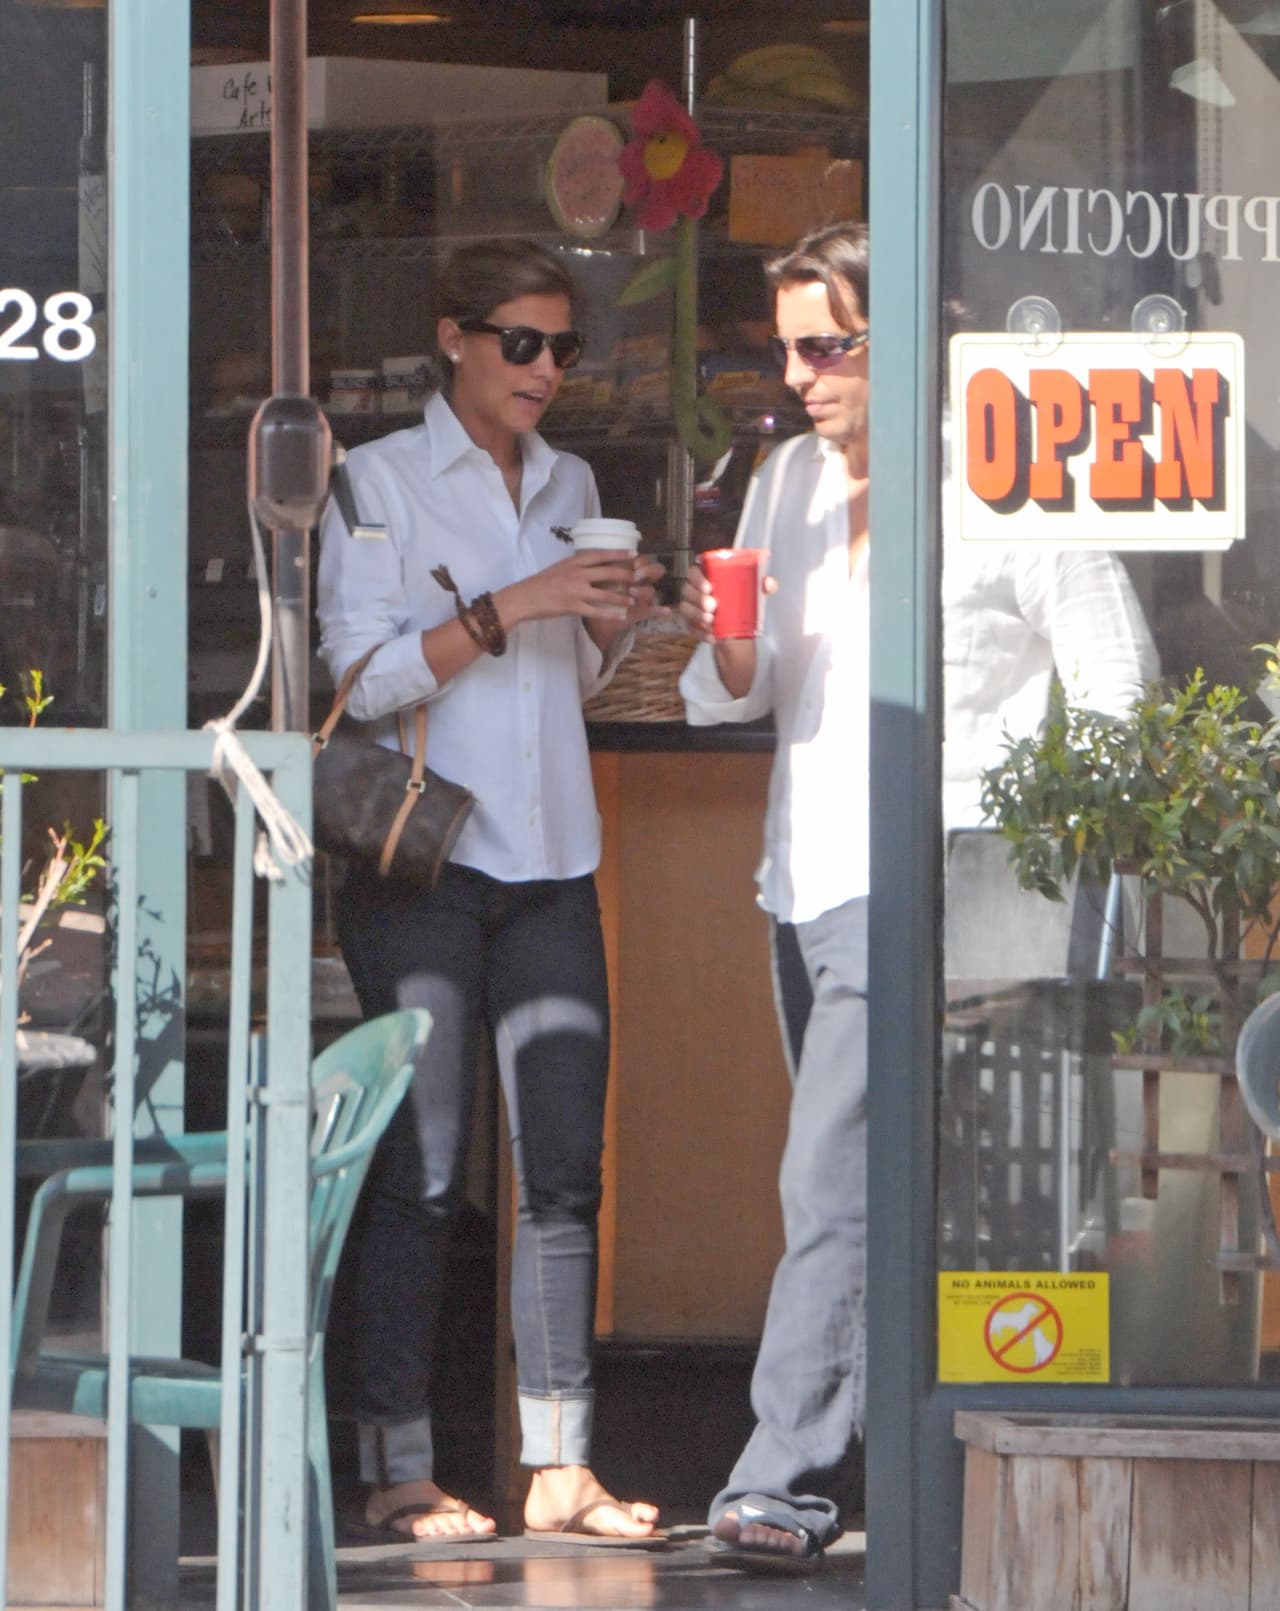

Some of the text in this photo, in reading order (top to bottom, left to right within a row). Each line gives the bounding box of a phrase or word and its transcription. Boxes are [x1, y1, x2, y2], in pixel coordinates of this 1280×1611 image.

[223, 71, 257, 105] Cafe
[0, 287, 96, 362] 28
[966, 367, 1231, 515] OPEN
[952, 1280, 1096, 1289] NO ANIMALS ALLOWED
